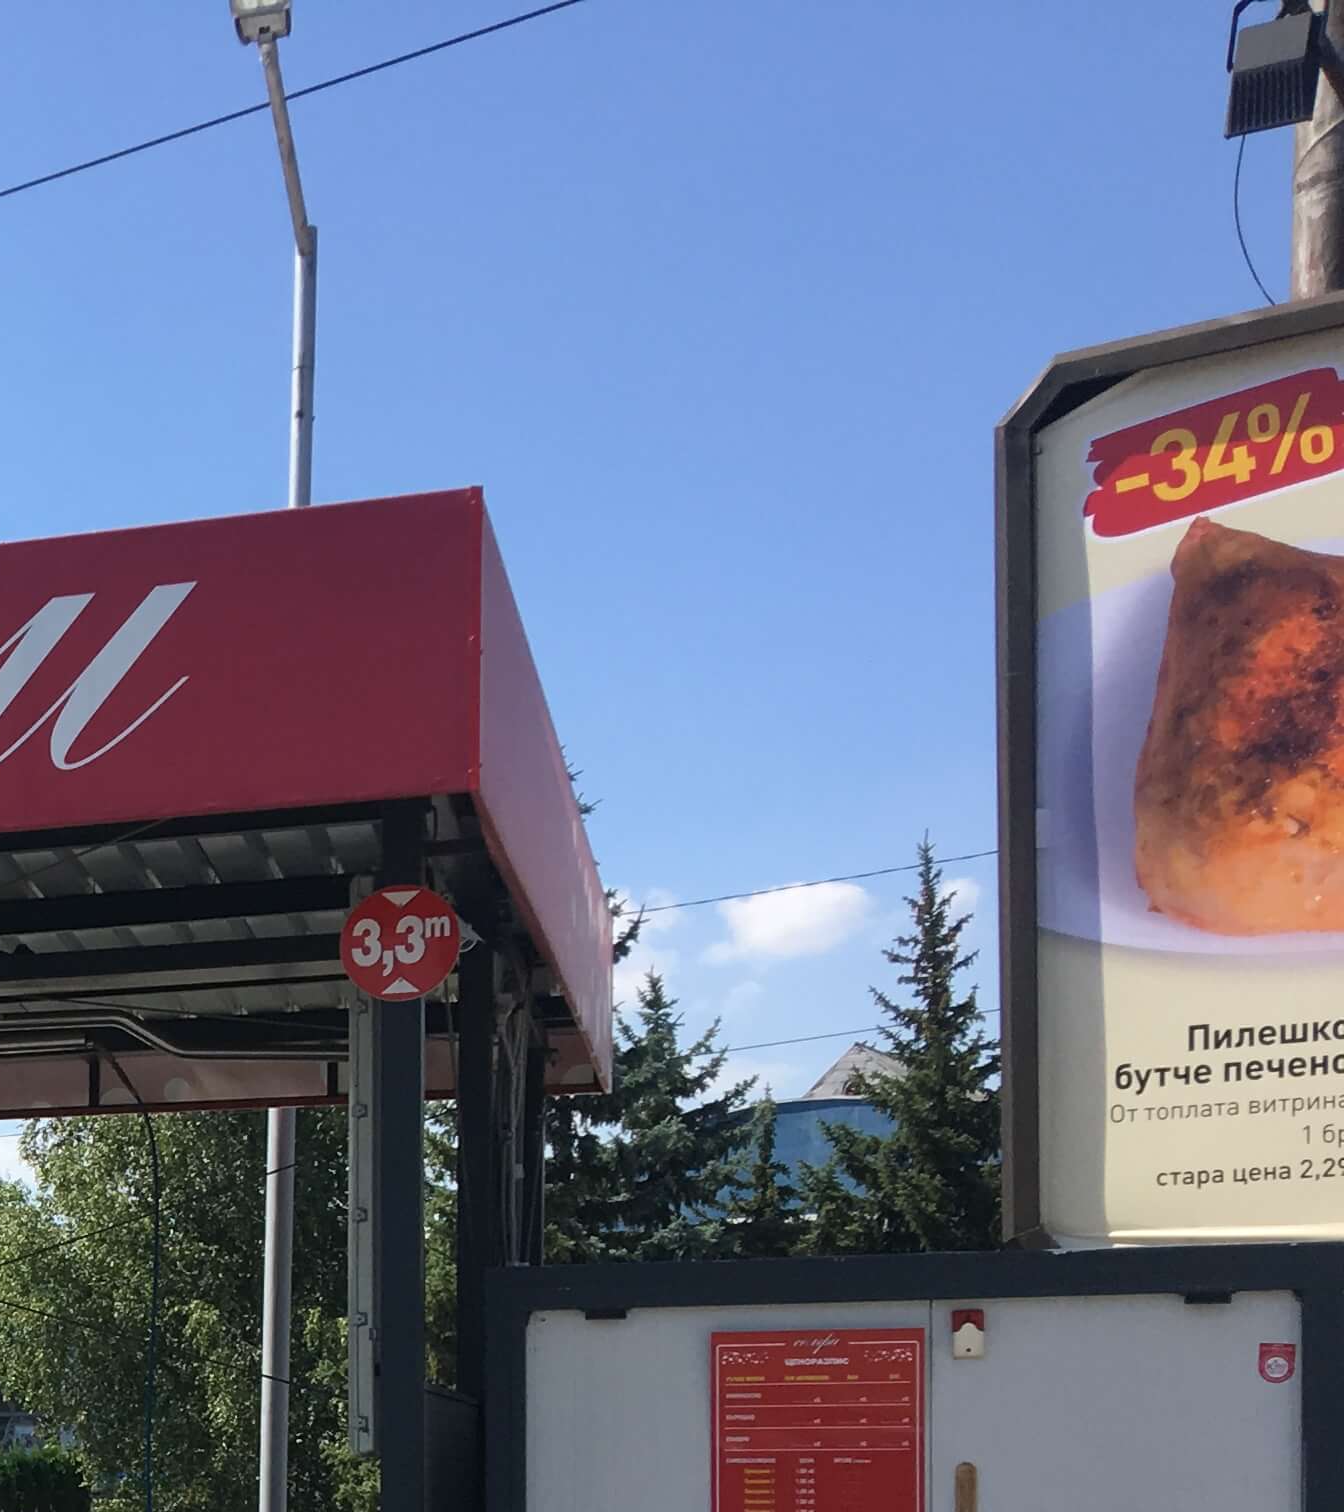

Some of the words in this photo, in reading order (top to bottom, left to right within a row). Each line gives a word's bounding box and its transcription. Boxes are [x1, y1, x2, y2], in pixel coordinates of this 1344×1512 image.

[1115, 392, 1334, 502] -34%
[1114, 1062, 1213, 1096] бутче
[1111, 1103, 1139, 1124] От
[1144, 1100, 1240, 1121] топлата
[1302, 1124, 1311, 1145] 1
[1155, 1168, 1225, 1189] стара
[1232, 1164, 1292, 1185] цена
